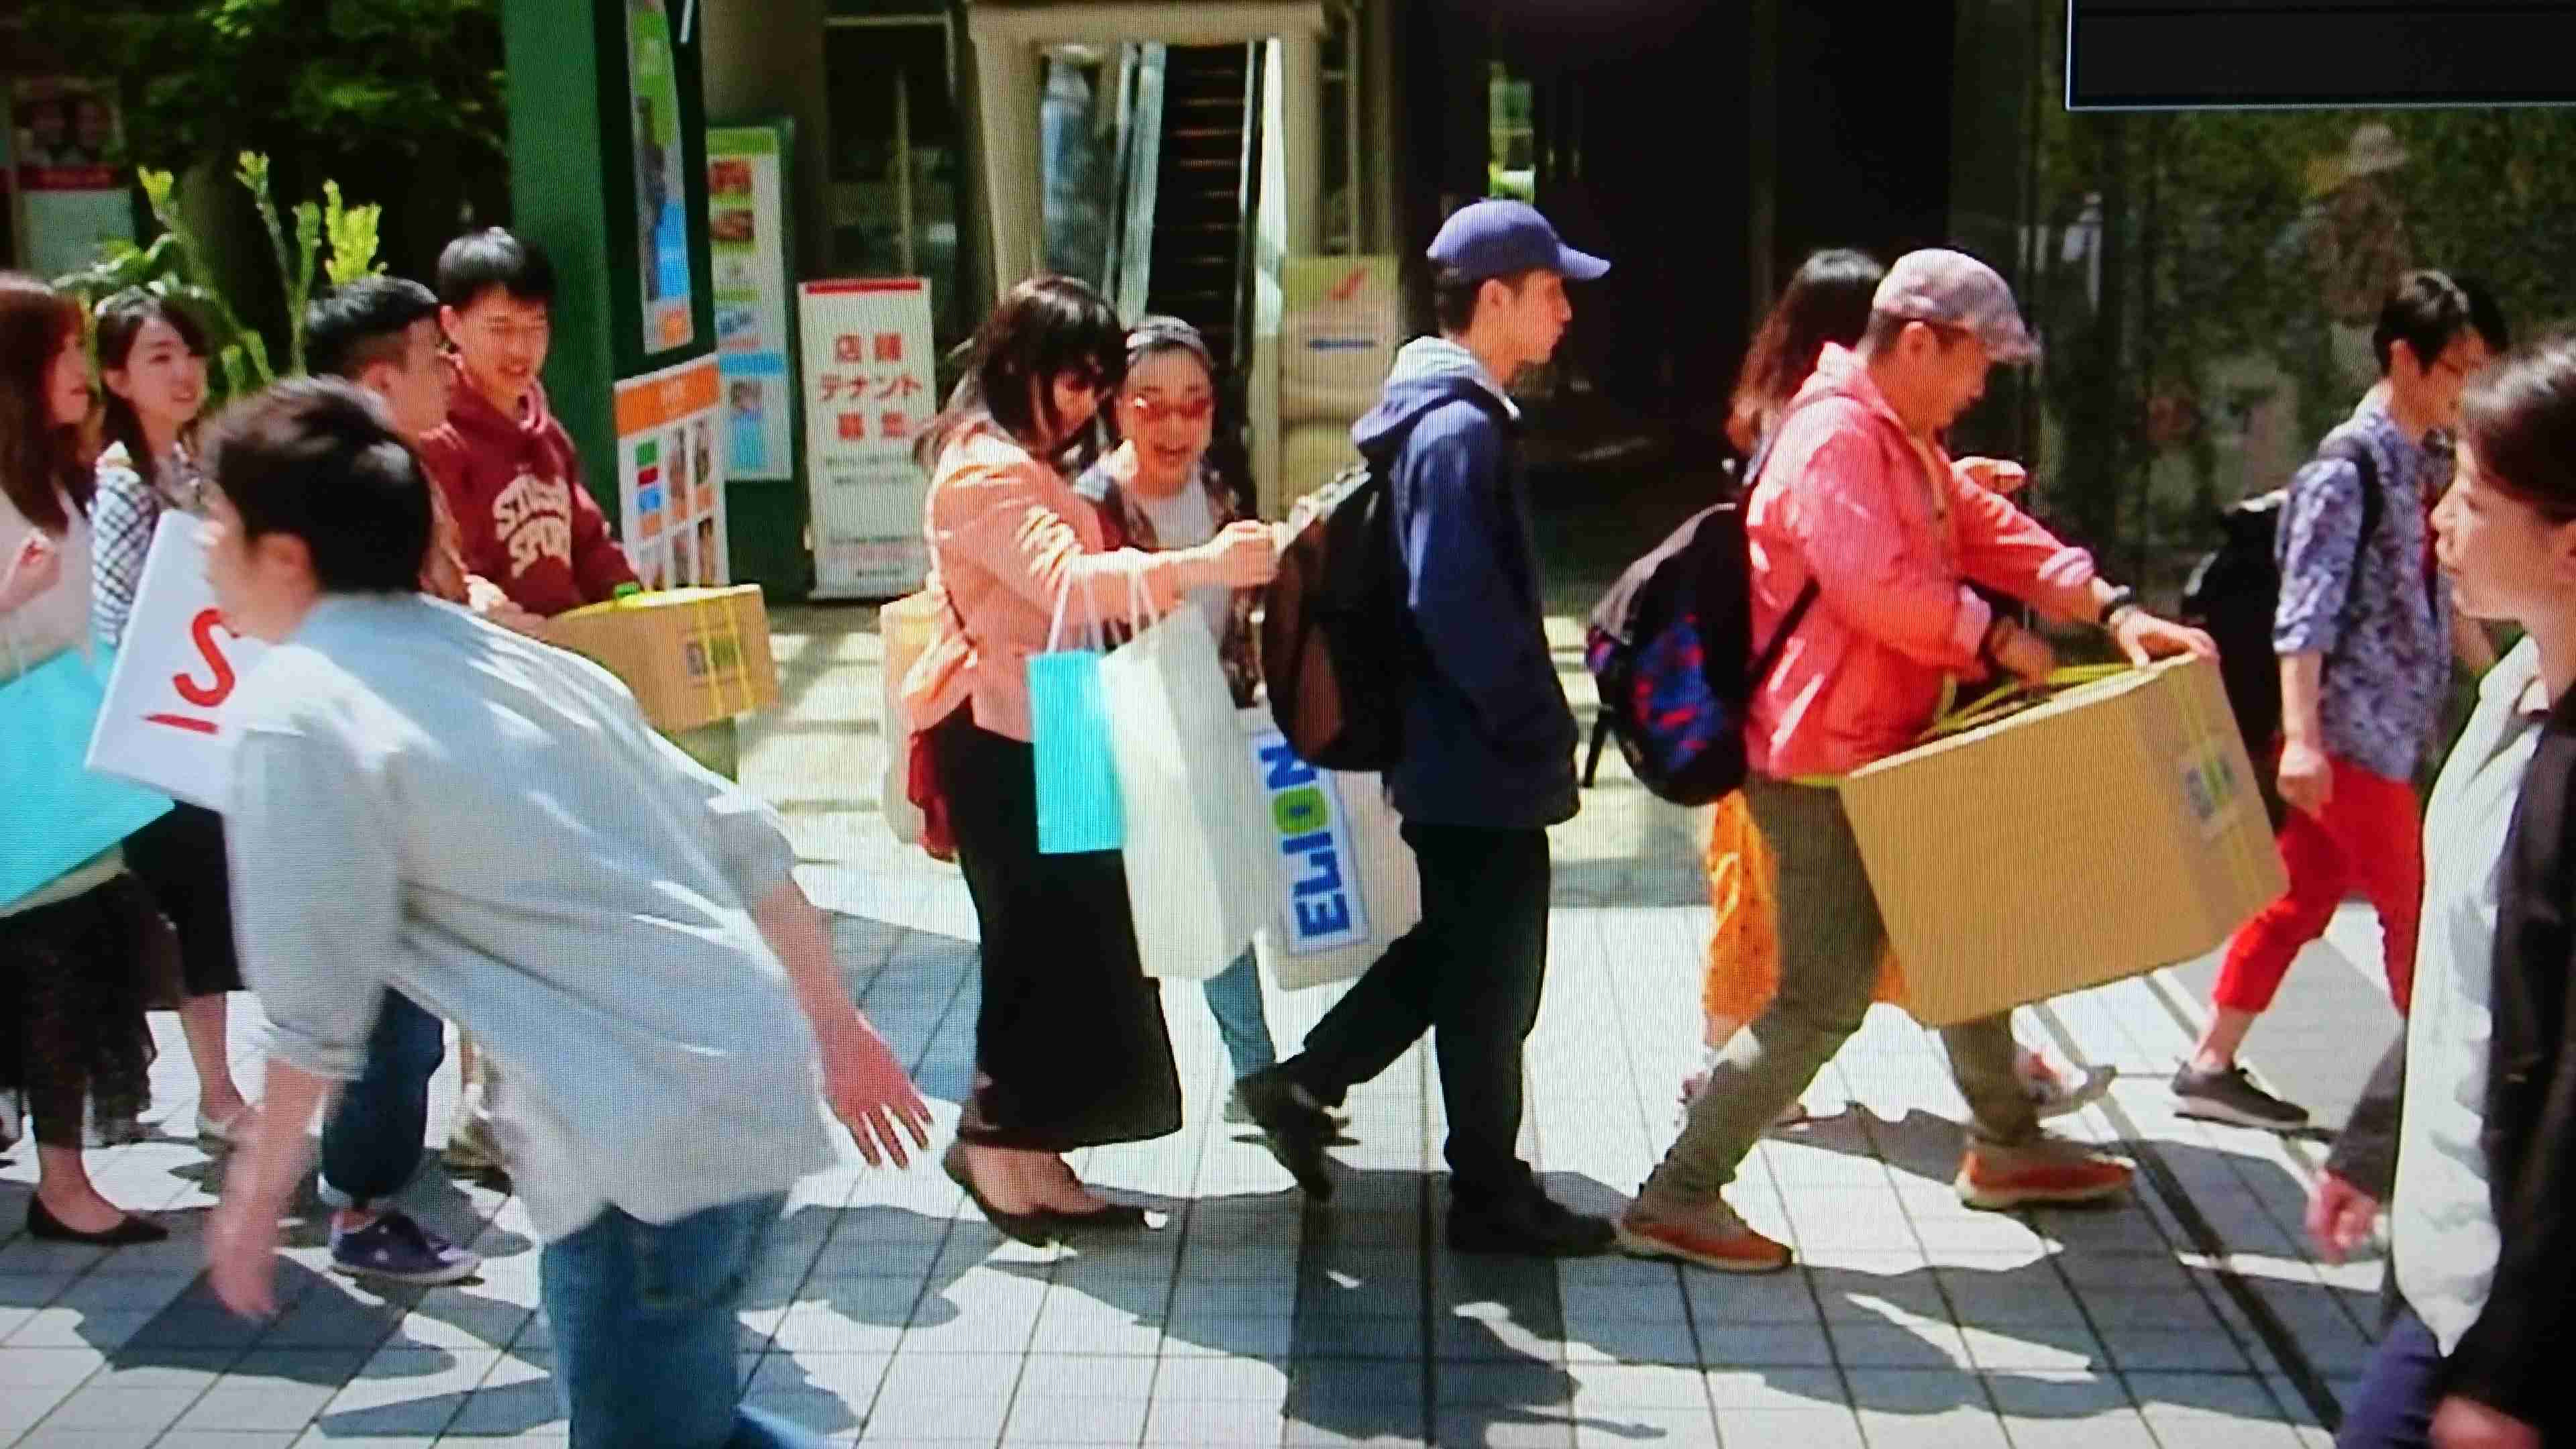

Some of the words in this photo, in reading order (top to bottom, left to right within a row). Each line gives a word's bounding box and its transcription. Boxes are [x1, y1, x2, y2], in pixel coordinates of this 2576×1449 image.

[818, 372, 923, 404] テナント
[1258, 741, 1350, 936] ELION
